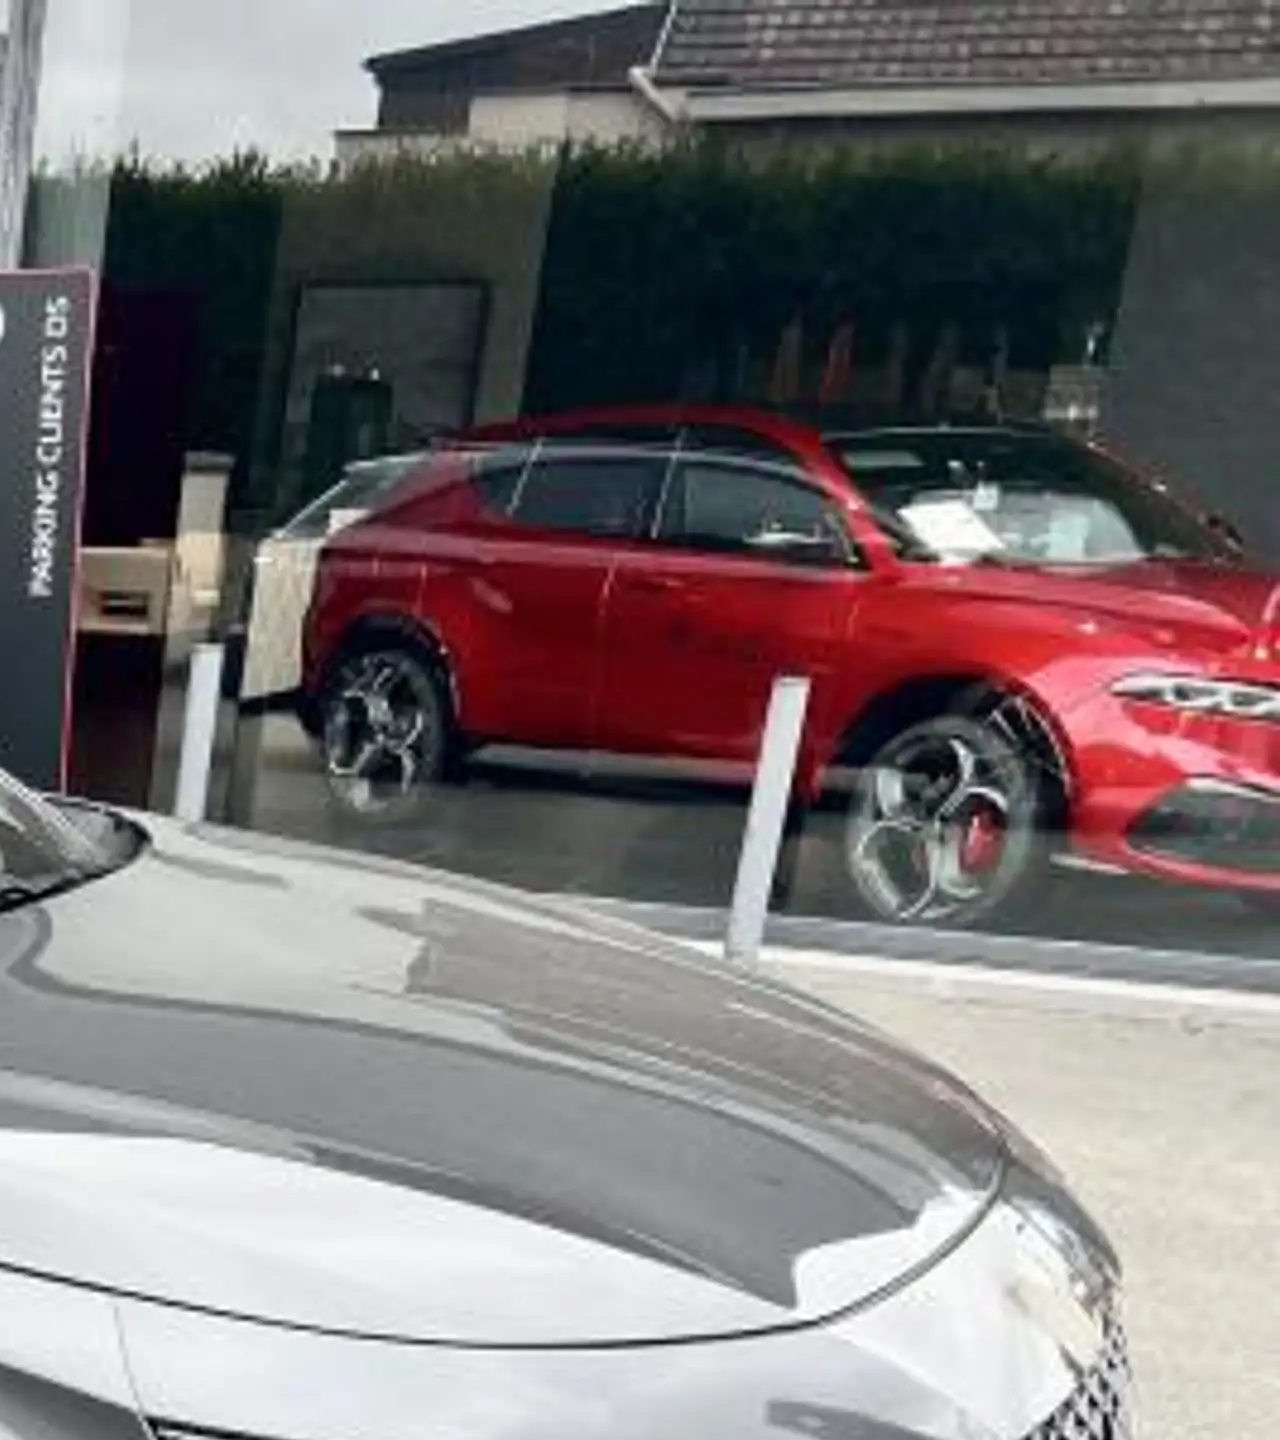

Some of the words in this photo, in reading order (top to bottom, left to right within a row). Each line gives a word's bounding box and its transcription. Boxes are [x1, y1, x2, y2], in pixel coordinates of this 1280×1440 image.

[44, 295, 71, 338] DS
[36, 345, 68, 464] CLIENTS
[27, 470, 60, 597] PARKING
